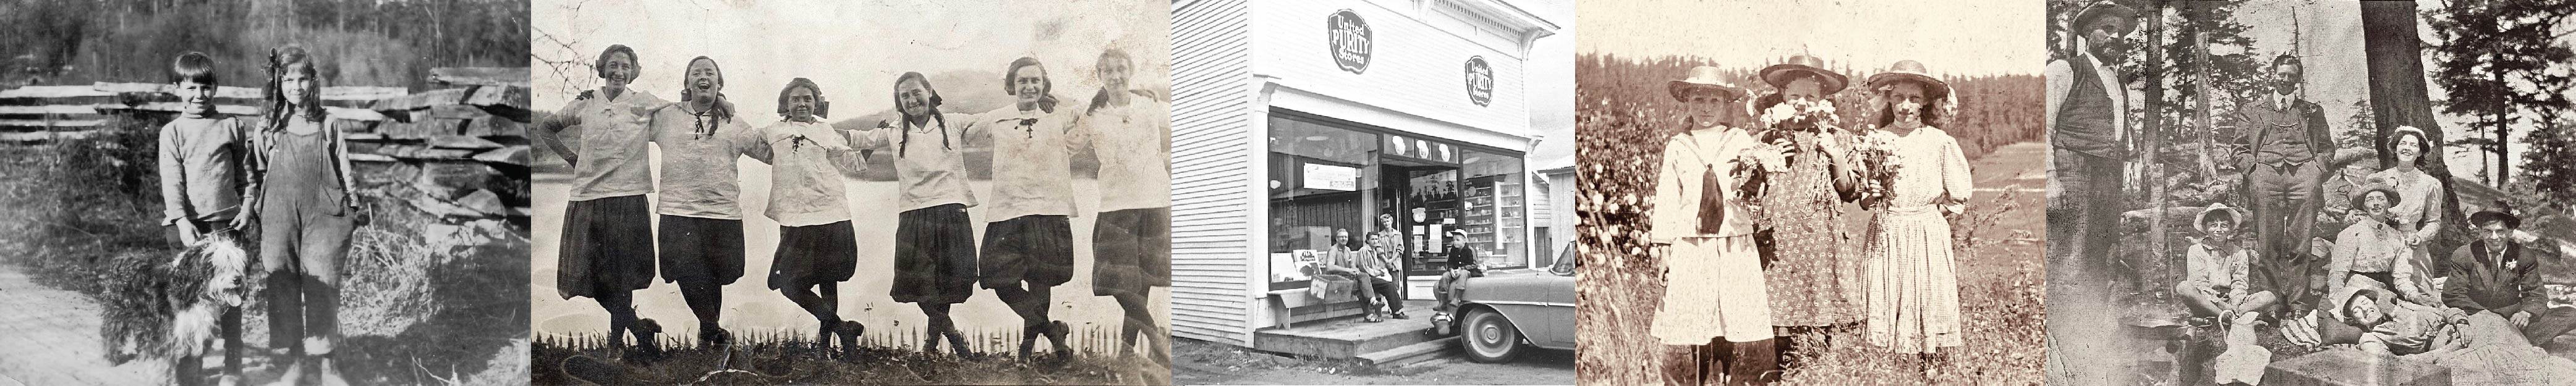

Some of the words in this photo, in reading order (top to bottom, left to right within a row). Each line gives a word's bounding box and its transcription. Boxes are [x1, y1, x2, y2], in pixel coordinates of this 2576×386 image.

[1338, 15, 1364, 35] United
[1332, 29, 1369, 54] PURITY
[1339, 48, 1364, 64] Stores
[1472, 61, 1489, 75] United
[1468, 73, 1491, 90] PURITY
[1473, 87, 1489, 99] Stores
